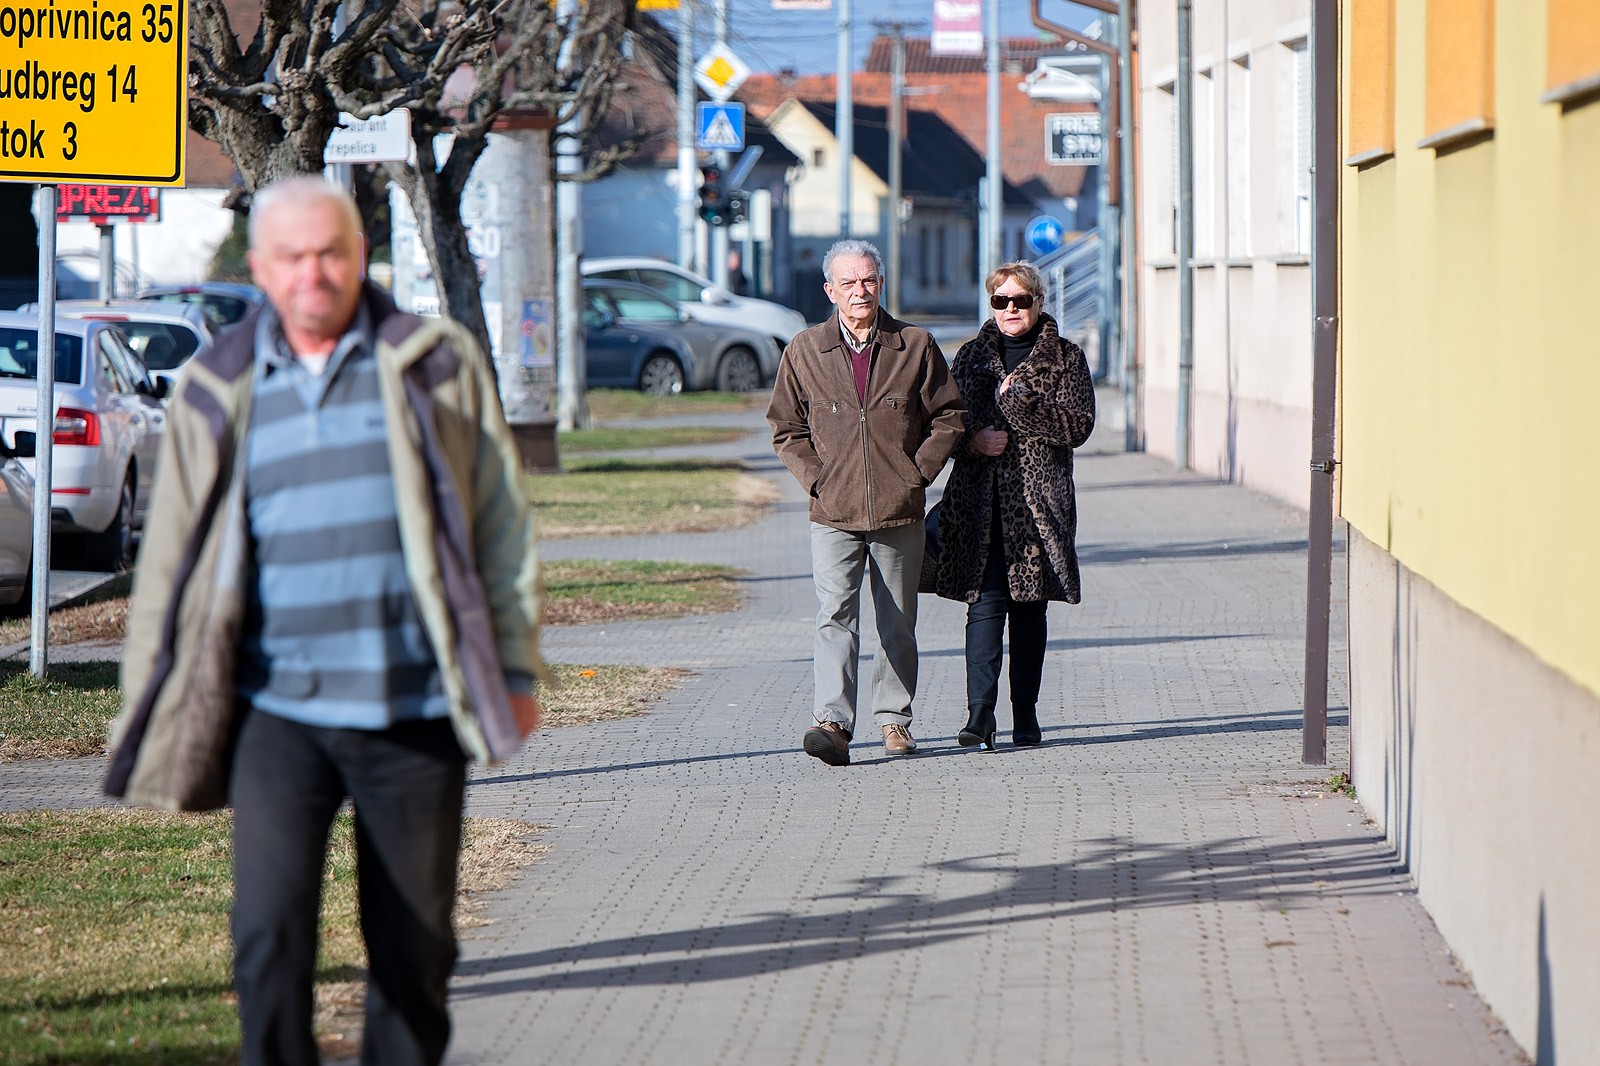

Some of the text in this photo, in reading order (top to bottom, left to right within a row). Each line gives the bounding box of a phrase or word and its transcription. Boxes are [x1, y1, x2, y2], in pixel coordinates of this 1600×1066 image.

[0, 0, 173, 48] oprivnica 35
[0, 60, 138, 113] udbreg 14
[0, 119, 78, 161] tok 3
